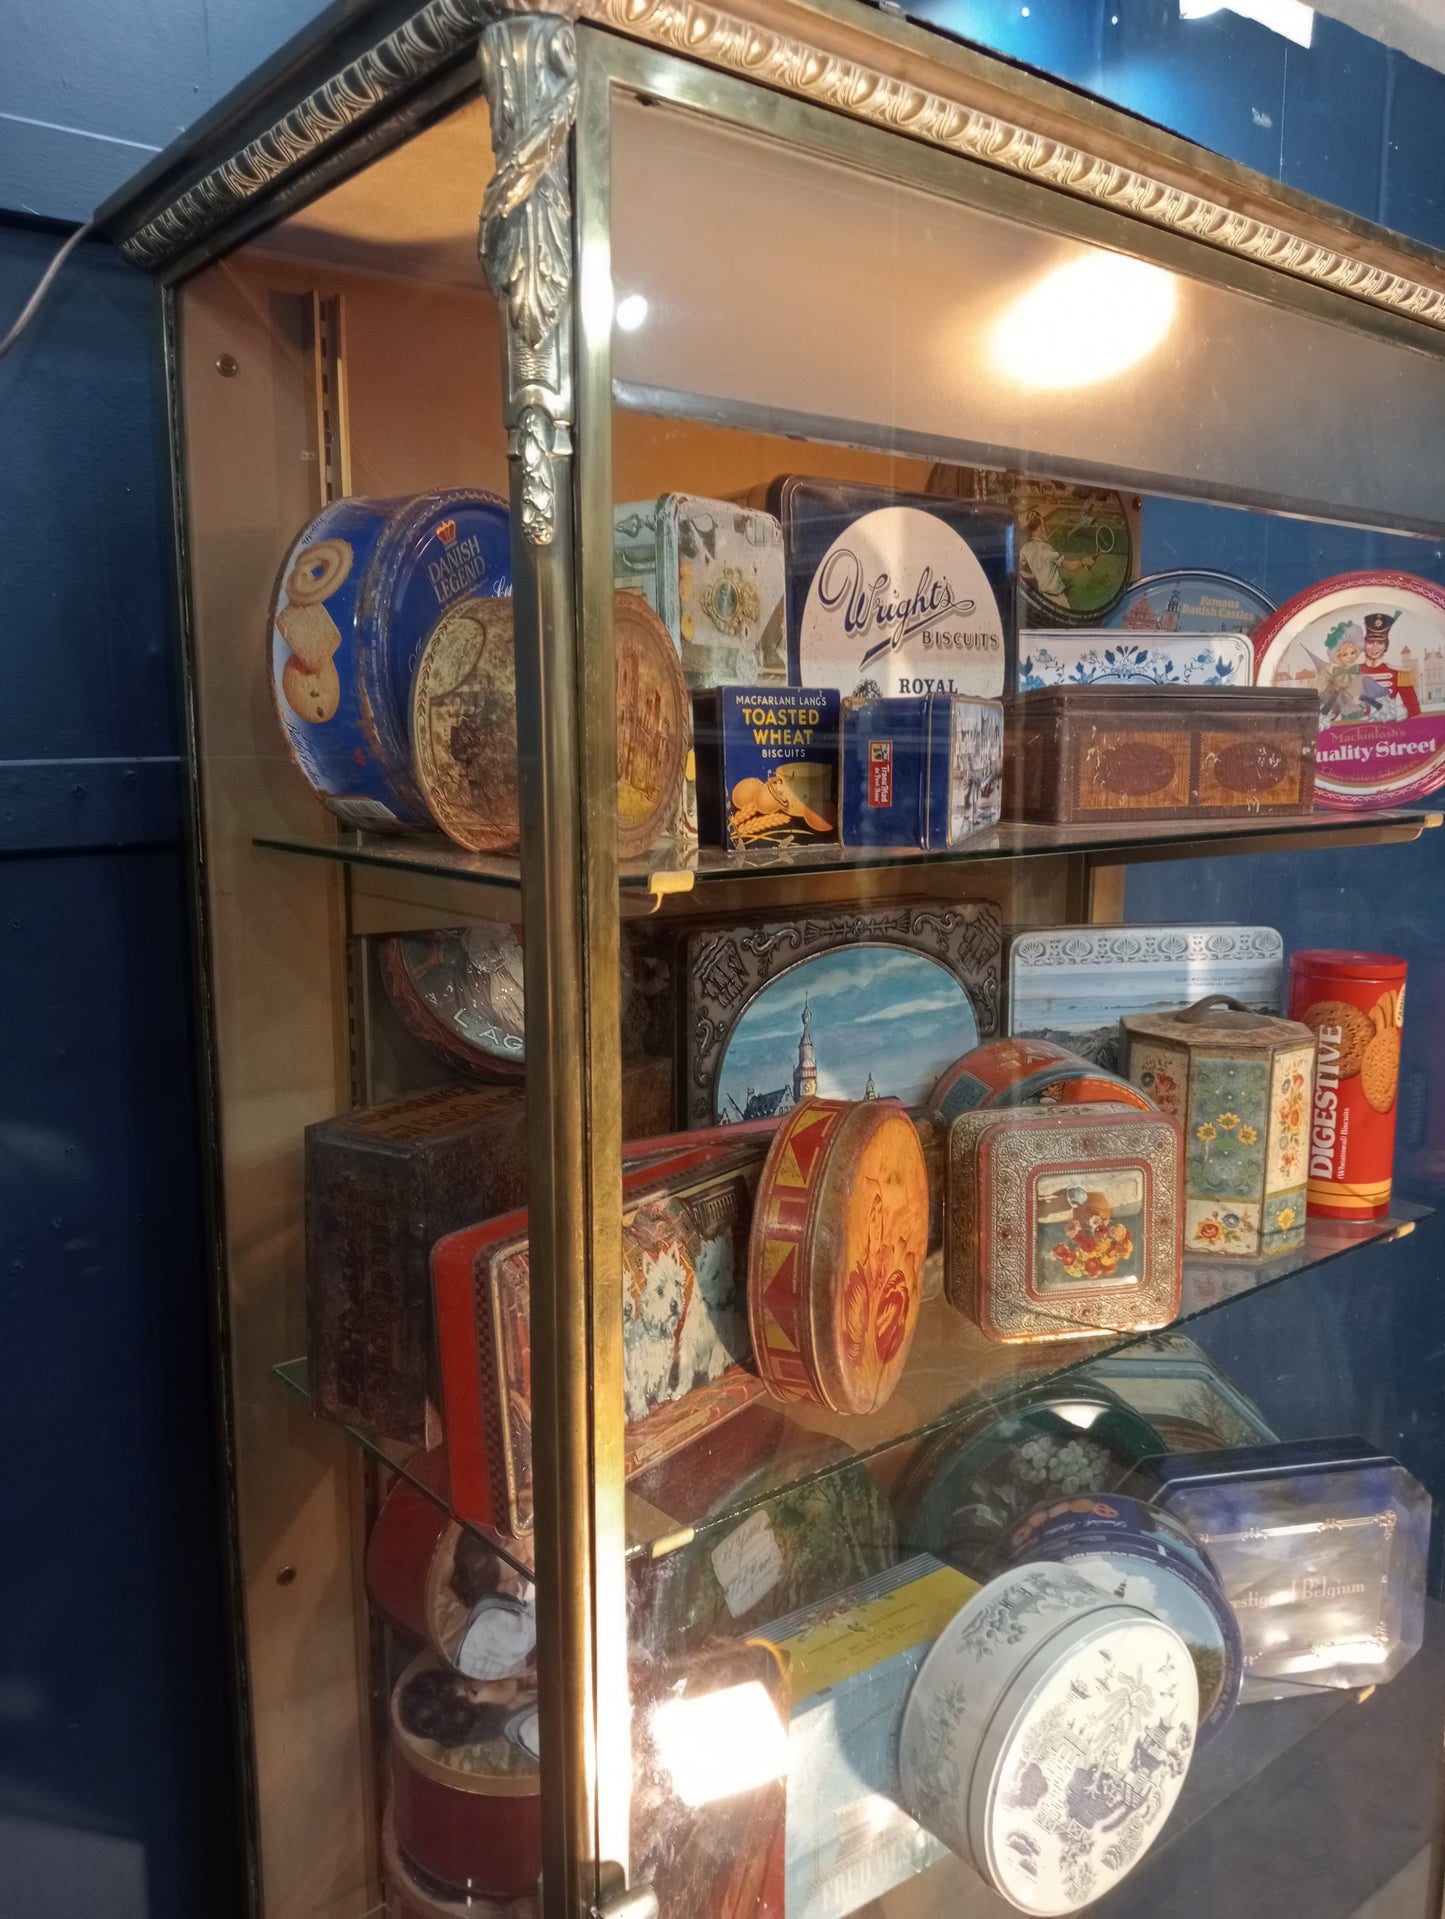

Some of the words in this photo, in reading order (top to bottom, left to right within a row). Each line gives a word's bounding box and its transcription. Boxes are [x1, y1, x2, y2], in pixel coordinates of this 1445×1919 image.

[428, 535, 481, 584] DANISH
[433, 556, 486, 604] LEGEND
[818, 548, 976, 652] Wright's
[1201, 596, 1240, 609] Famous
[1182, 603, 1217, 617] Danish
[1219, 607, 1255, 620] Castles
[921, 630, 1000, 649] BISCUITS
[899, 677, 958, 695] ROYAL
[735, 695, 796, 706] MACFARLANE
[742, 708, 820, 726] TOASTED
[753, 729, 814, 746] WHEAT
[762, 748, 806, 759] BISCUITS
[1315, 743, 1374, 763] uality
[1375, 738, 1437, 758] Street
[1310, 1024, 1343, 1180] DIGESTIVE
[1340, 1108, 1350, 1136] Biscuits
[1302, 1576, 1365, 1601] Belgium
